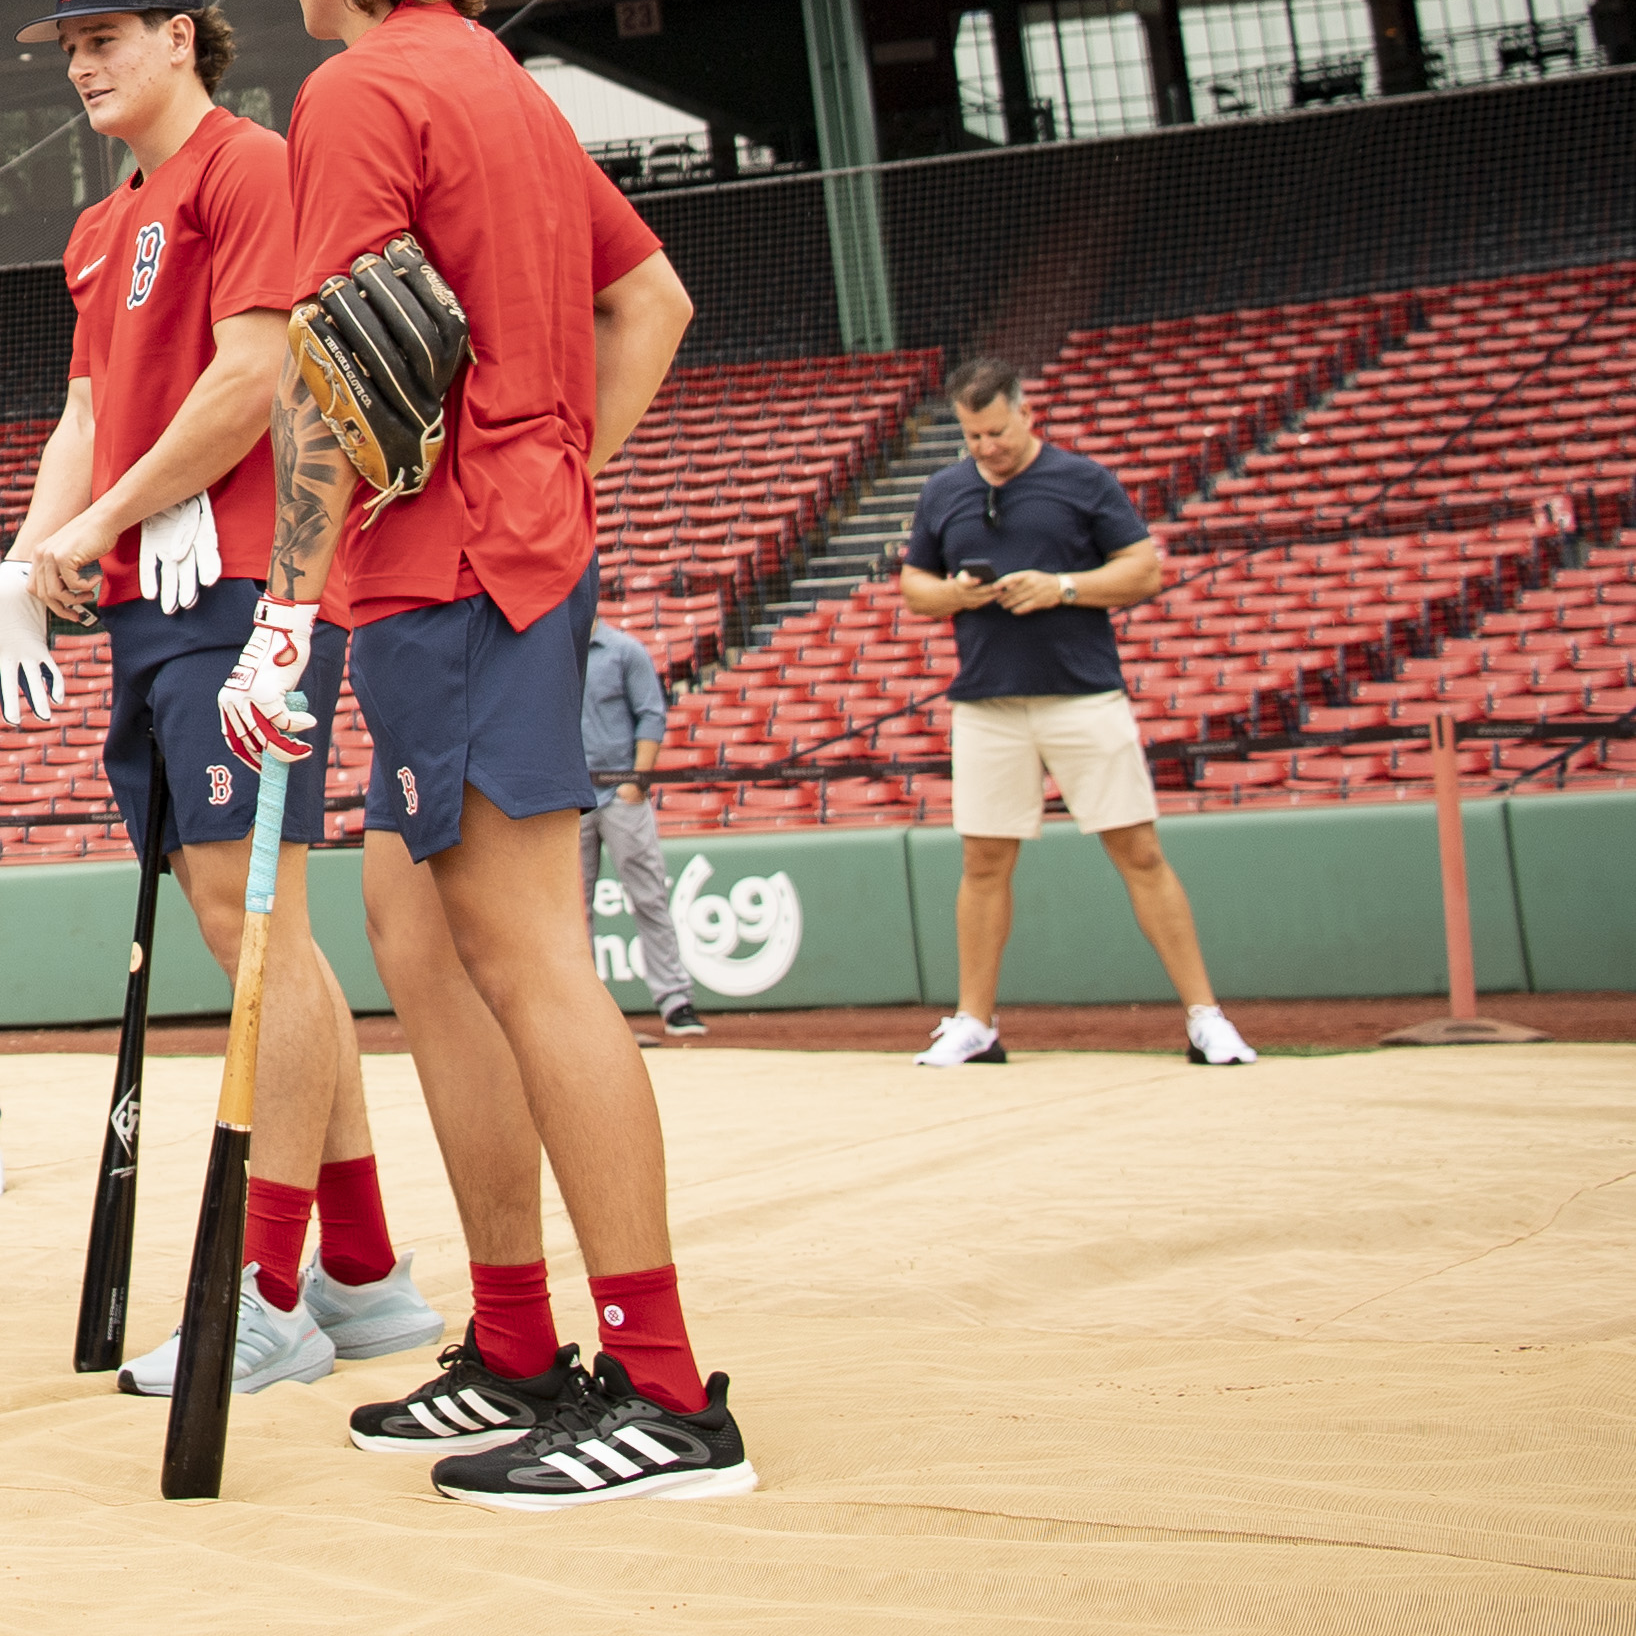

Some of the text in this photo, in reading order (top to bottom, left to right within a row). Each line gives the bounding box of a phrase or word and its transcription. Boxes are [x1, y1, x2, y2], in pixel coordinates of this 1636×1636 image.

[125, 220, 166, 312] B
[324, 335, 339, 353] THE
[334, 350, 351, 377] GOLD
[344, 371, 363, 398] GLOVE
[205, 763, 234, 808] B
[396, 764, 419, 816] B
